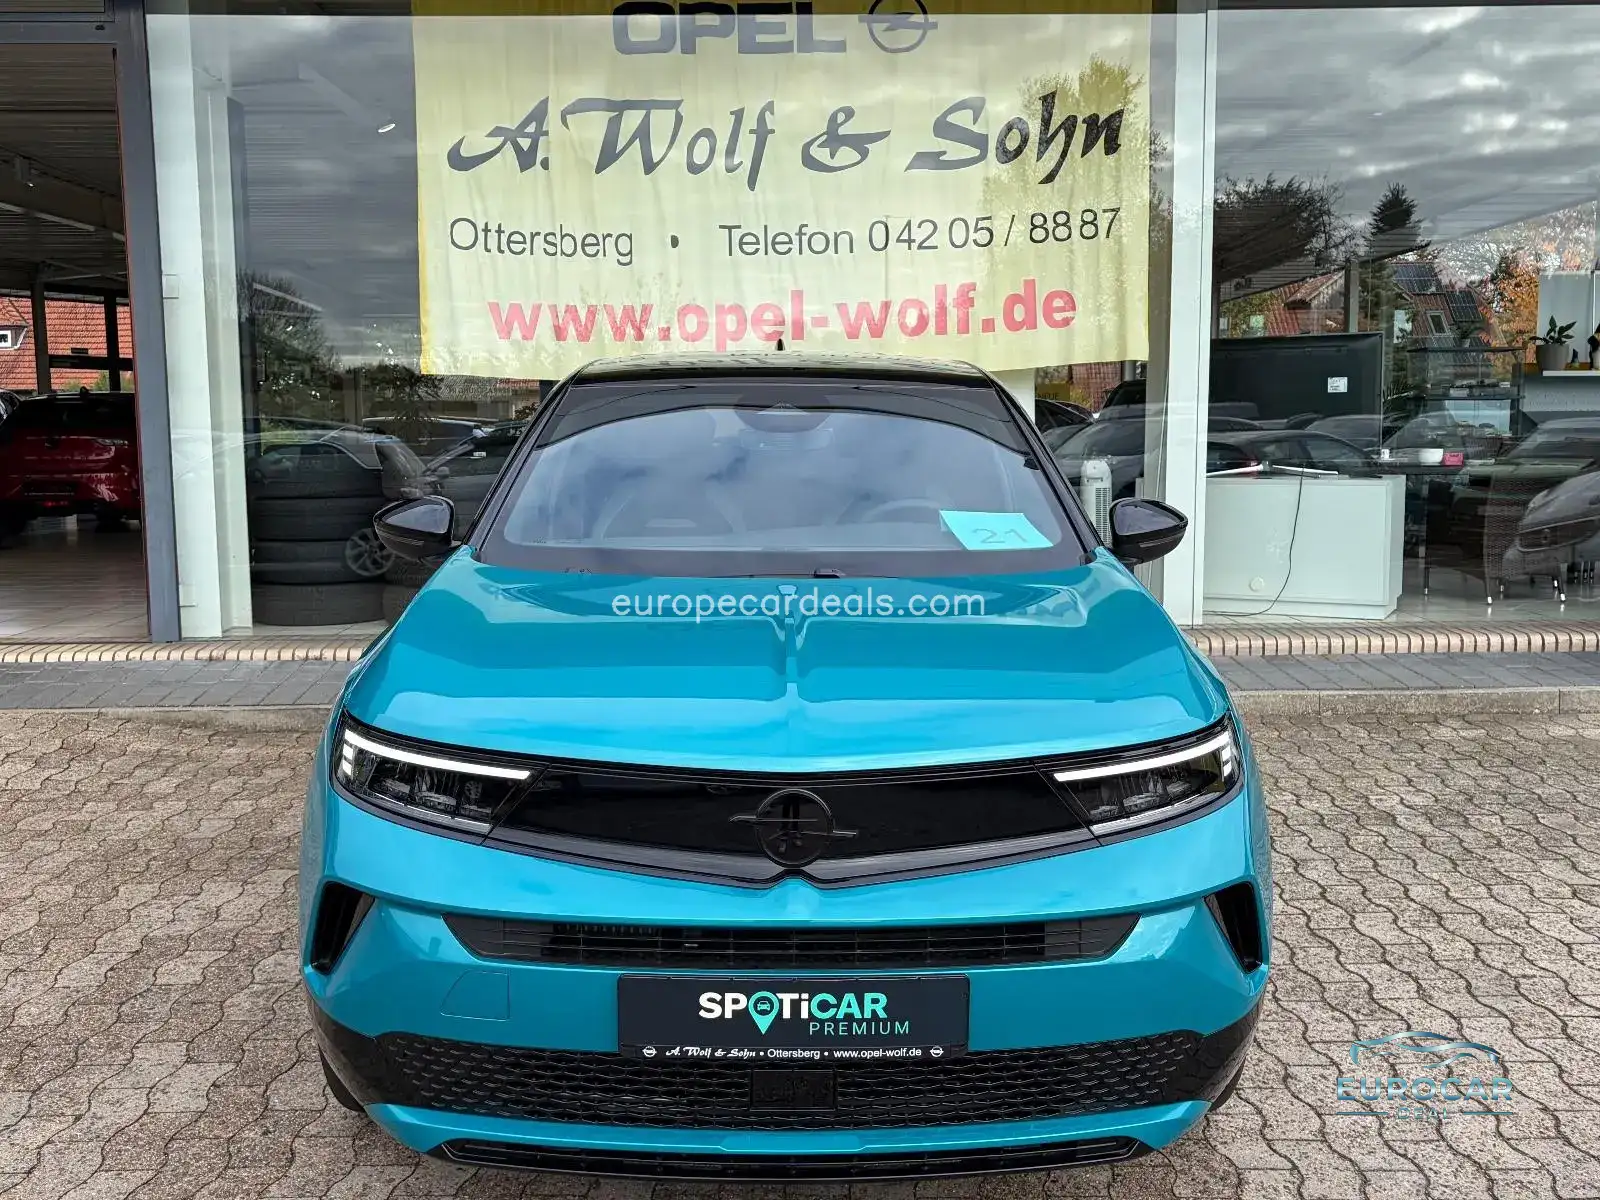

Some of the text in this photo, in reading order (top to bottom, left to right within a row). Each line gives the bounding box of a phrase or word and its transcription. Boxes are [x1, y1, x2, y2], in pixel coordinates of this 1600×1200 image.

[612, 1, 847, 54] OPEL
[446, 90, 1124, 191] A. Wolf & Sohn
[450, 217, 633, 266] Ottersberg
[718, 224, 854, 257] Telefon
[488, 278, 1078, 352] www.opel-wolf.de
[682, 1046, 712, 1059] Wolf
[714, 1048, 727, 1057] &
[727, 1048, 756, 1060] Sohn
[767, 1048, 821, 1060] Ottersberg
[833, 1048, 922, 1059] www.opel-wolf.de
[809, 1021, 911, 1035] PREMIUM
